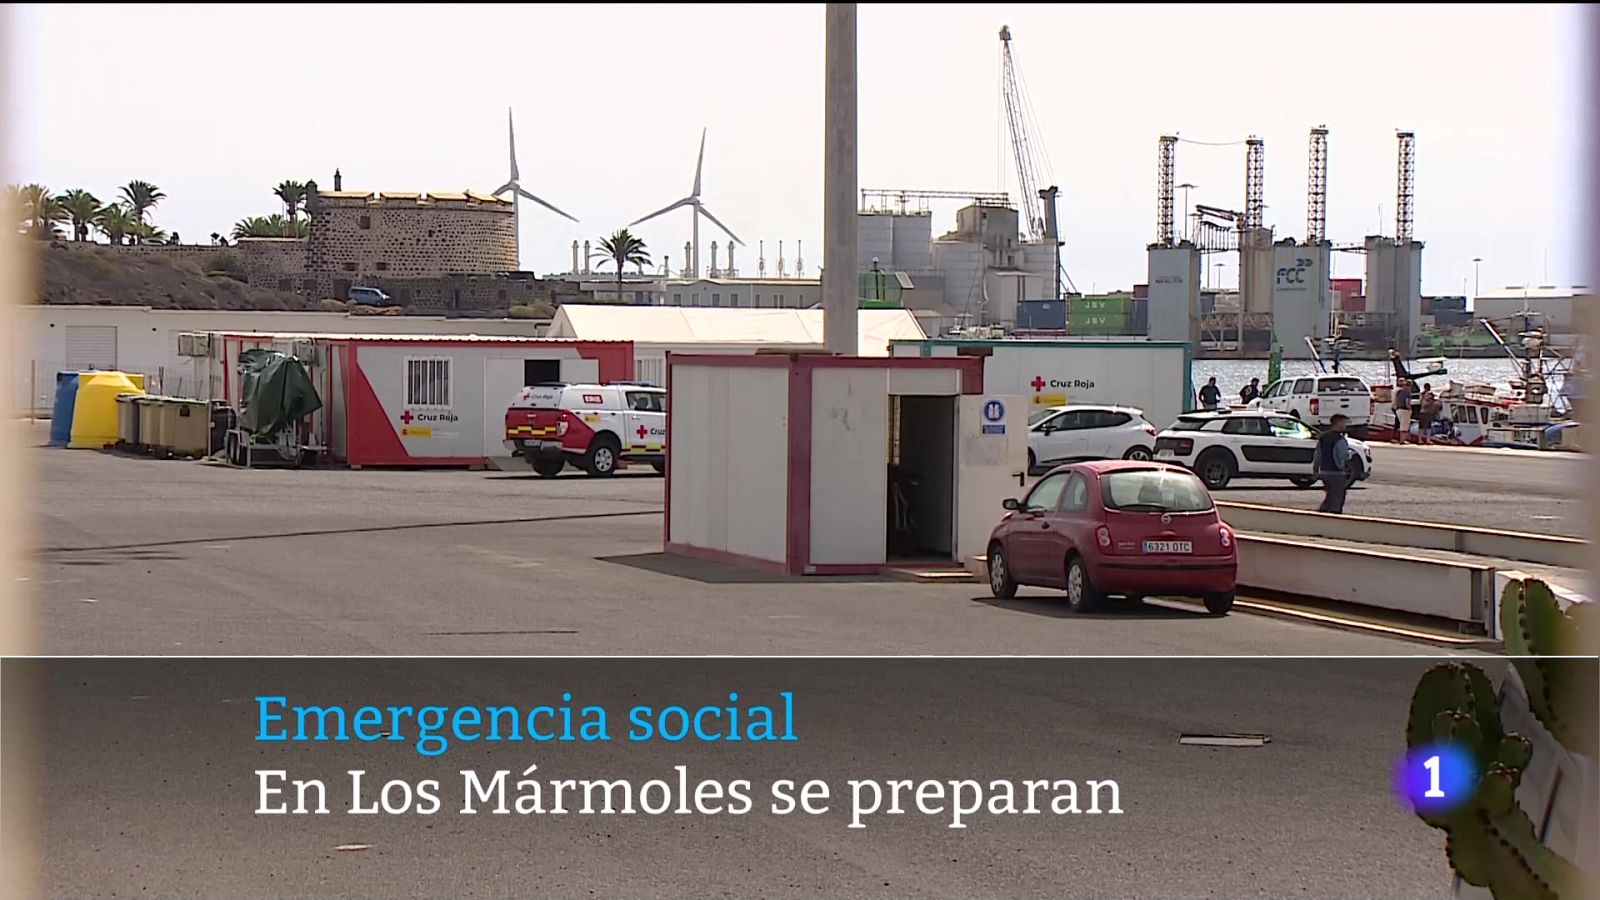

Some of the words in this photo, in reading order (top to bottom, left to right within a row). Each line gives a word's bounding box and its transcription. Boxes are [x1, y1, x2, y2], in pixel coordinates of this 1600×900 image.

[1277, 268, 1305, 284] FCC
[1050, 379, 1072, 388] Cruz
[1074, 379, 1095, 390] Roja
[417, 413, 438, 422] Cruz
[439, 413, 458, 423] Roja
[1148, 542, 1170, 552] 6321
